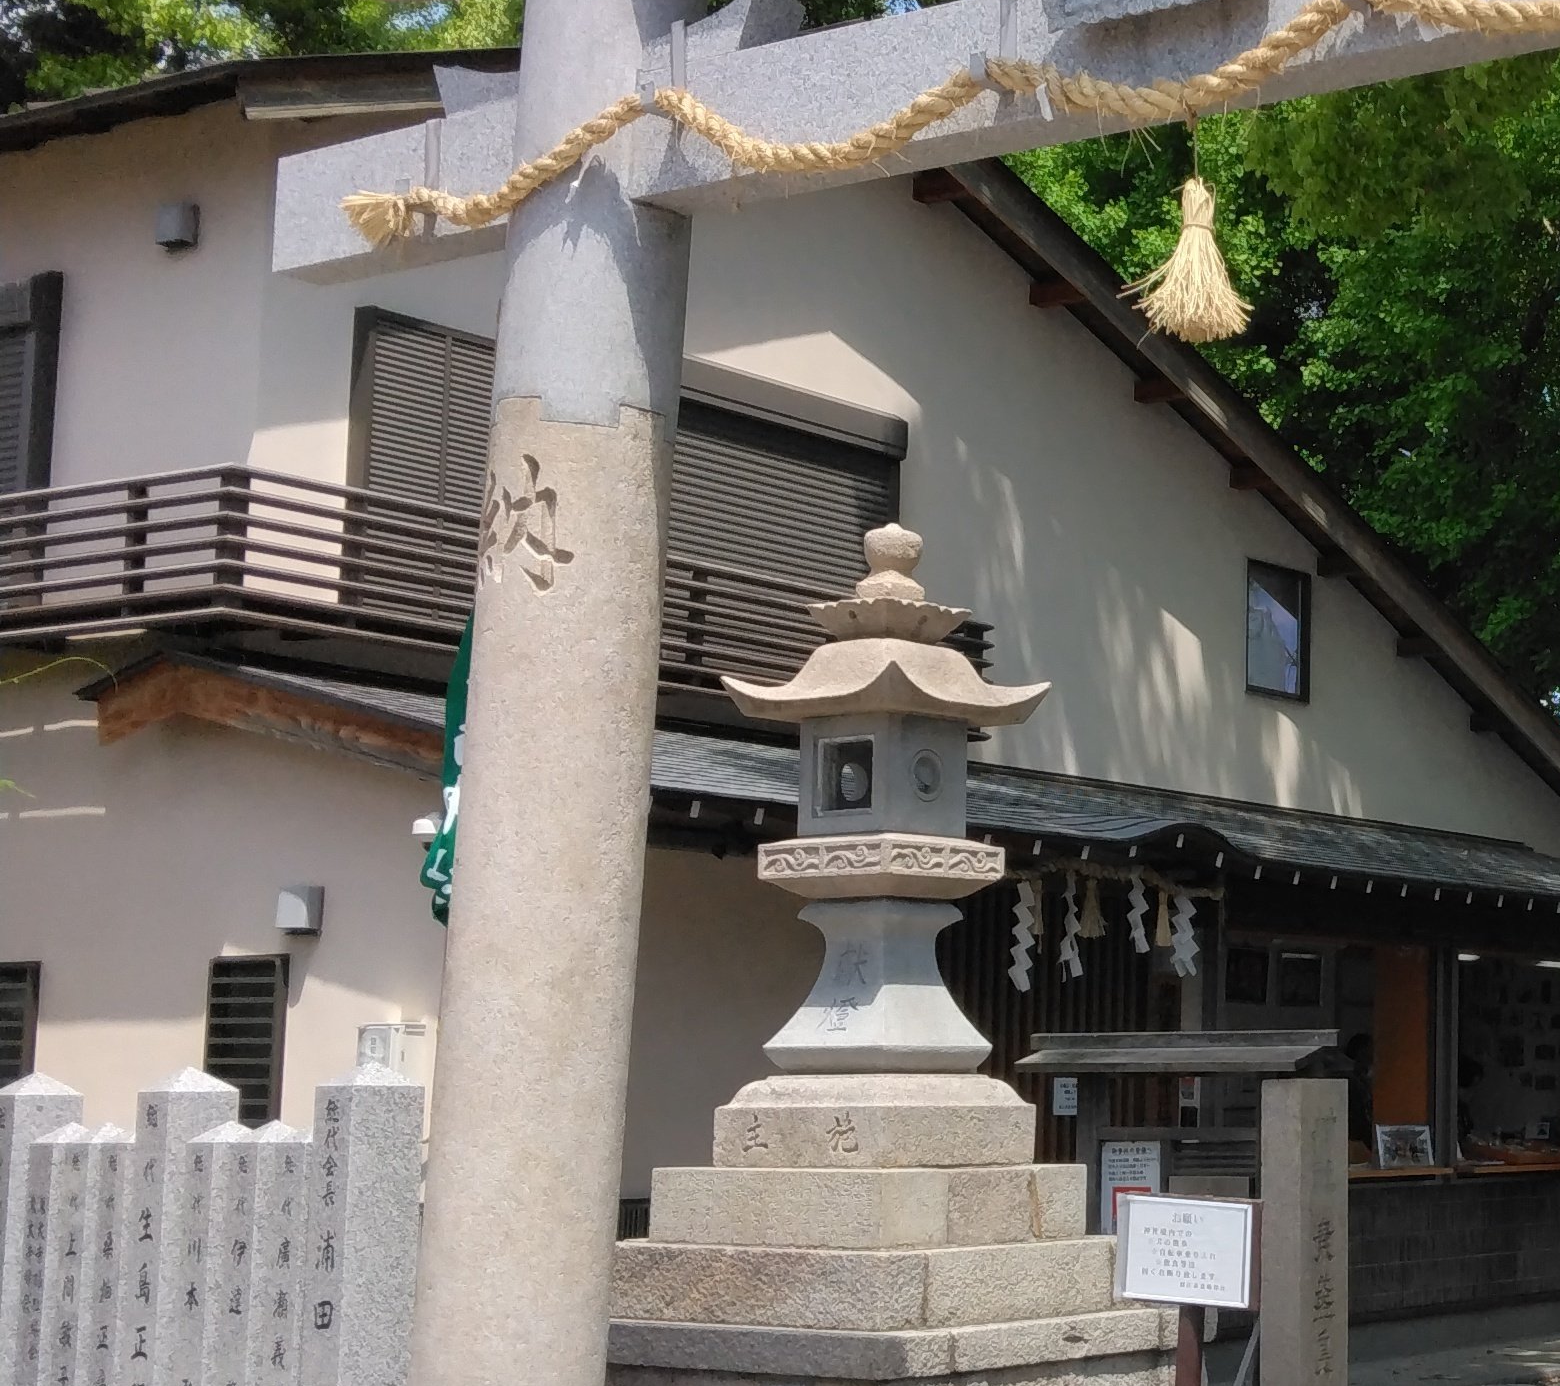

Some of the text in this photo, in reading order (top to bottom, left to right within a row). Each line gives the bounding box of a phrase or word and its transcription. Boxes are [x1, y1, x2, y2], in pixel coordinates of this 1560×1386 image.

[478, 453, 575, 592] 納
[1172, 1212, 1204, 1225] お願い
